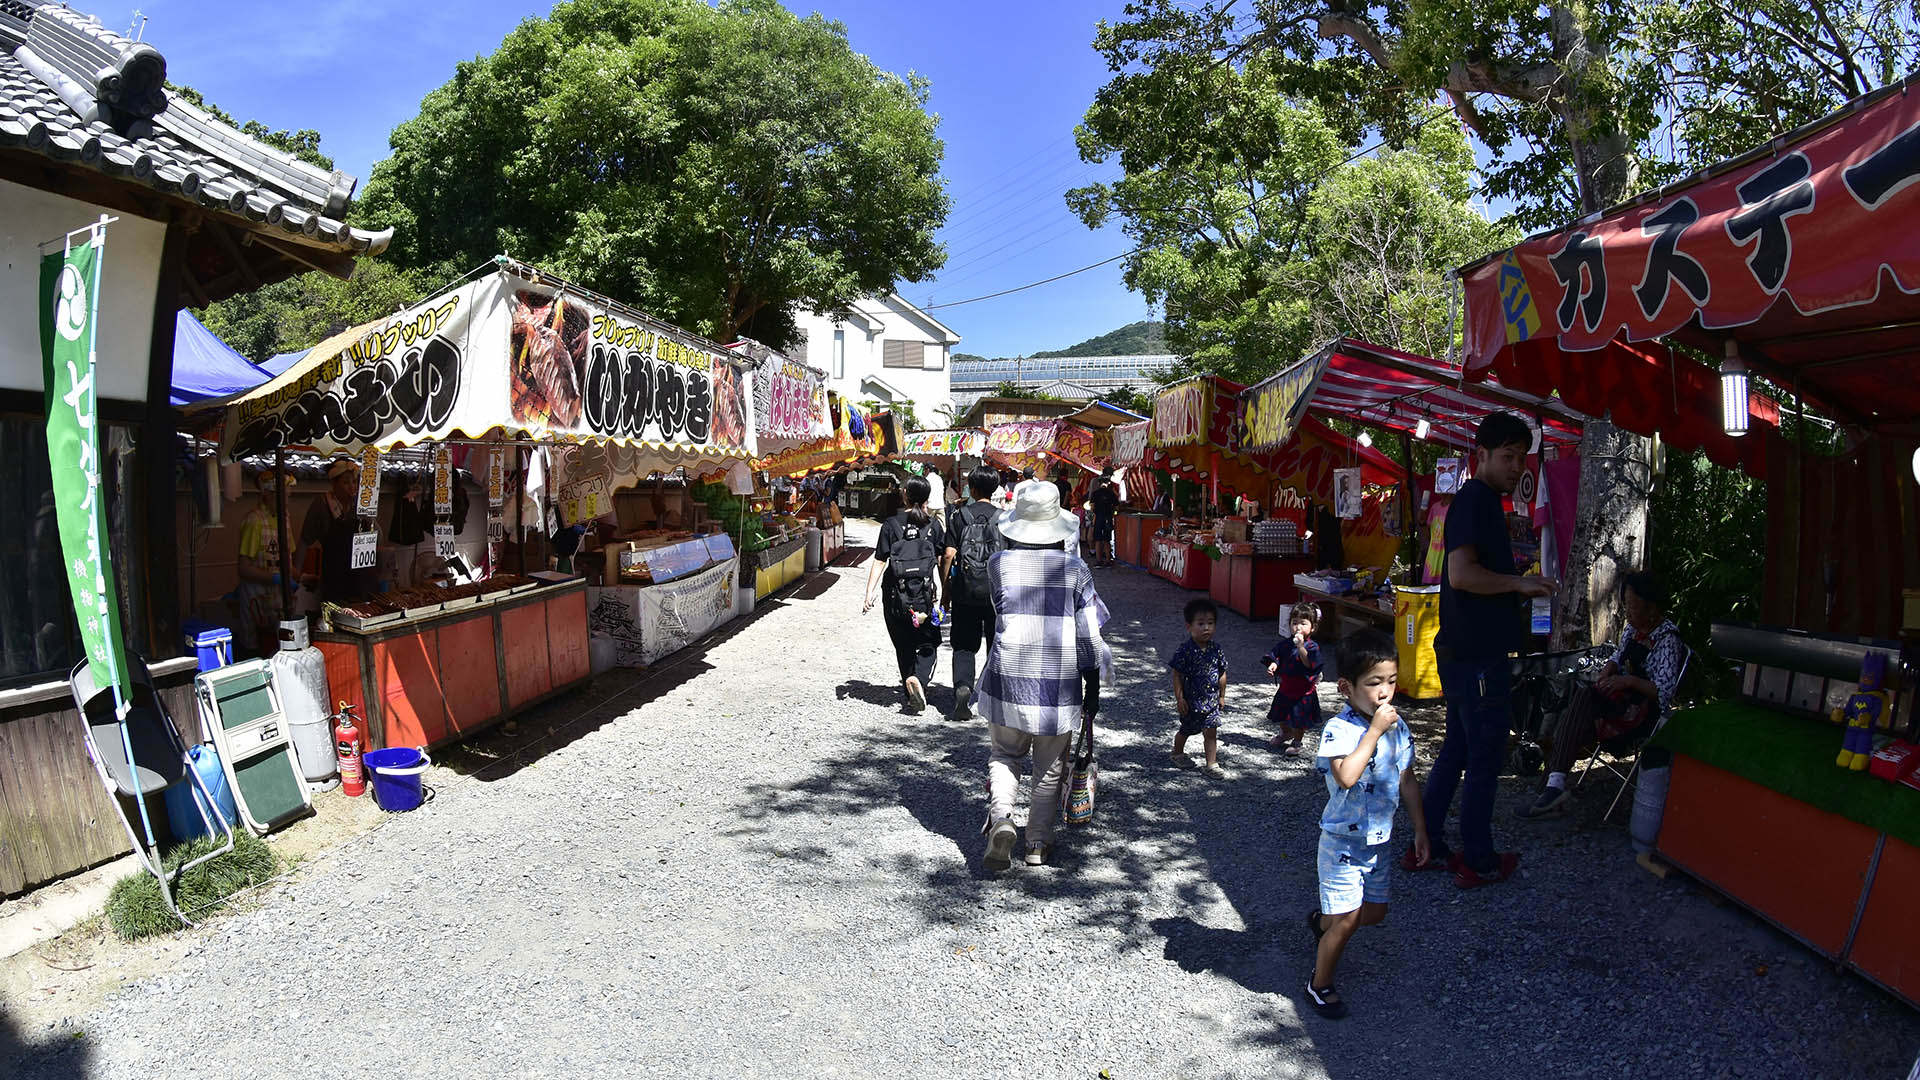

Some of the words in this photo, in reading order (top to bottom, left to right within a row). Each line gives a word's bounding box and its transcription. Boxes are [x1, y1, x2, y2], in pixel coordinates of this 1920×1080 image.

[584, 342, 713, 444] いかやき
[769, 371, 811, 434] はしまき
[488, 523, 502, 538] 400
[440, 541, 455, 555] 500
[354, 550, 376, 567] 1000
